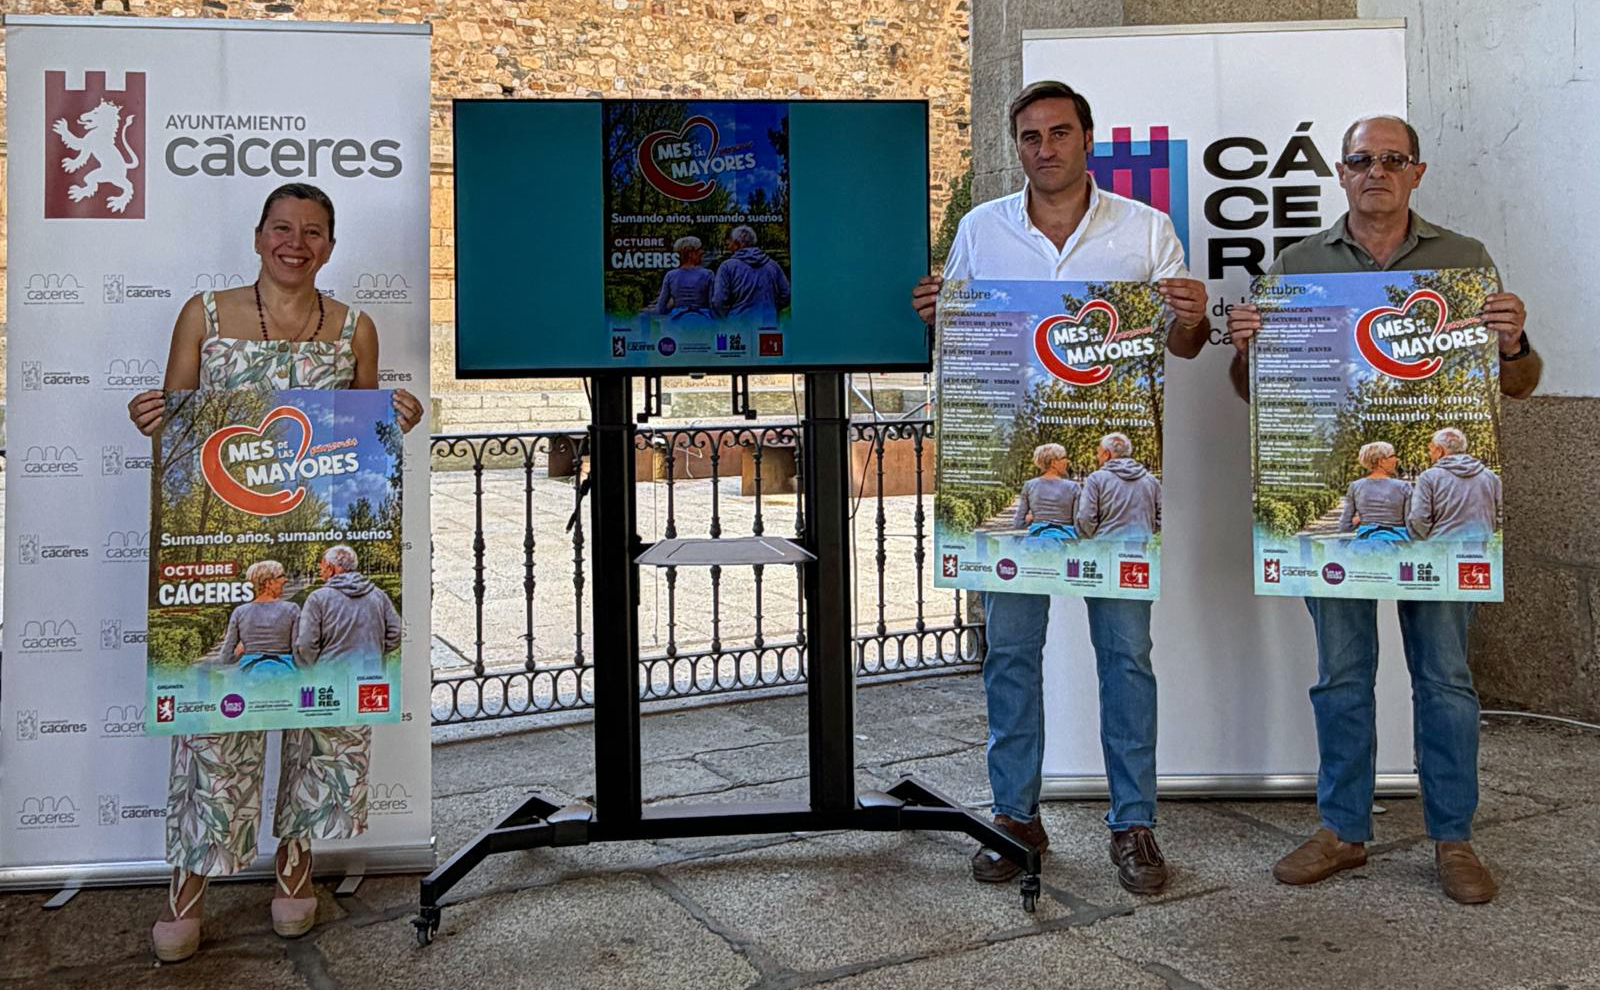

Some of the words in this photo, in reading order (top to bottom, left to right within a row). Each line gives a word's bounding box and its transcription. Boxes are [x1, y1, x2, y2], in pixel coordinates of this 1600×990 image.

[165, 114, 306, 131] AYUNTAMIENTO
[657, 142, 691, 161] MES
[1203, 121, 1334, 180] CÁ
[671, 153, 756, 179] MAYORES
[1204, 185, 1322, 231] CE
[611, 213, 664, 223] Sumando
[666, 213, 694, 225] años,
[696, 213, 745, 223] sumando
[747, 213, 783, 223] sueños
[614, 238, 665, 247] OCTUBRE
[611, 250, 680, 269] CÁCERES
[943, 288, 991, 300] Octubre
[1255, 284, 1306, 296] Octubre
[1053, 326, 1089, 345] MES
[1375, 318, 1415, 339] MES
[1417, 325, 1432, 334] LAS
[1090, 334, 1104, 343] LAS
[1391, 326, 1489, 359] MAYORES
[1066, 337, 1155, 365] MAYORES
[1039, 399, 1107, 410] Sumando
[1363, 394, 1438, 405] Sumando
[1359, 410, 1430, 421] sumando
[228, 439, 274, 463] MES
[277, 441, 289, 449] DE
[278, 449, 295, 459] LAS
[246, 452, 360, 487] MAYORES
[161, 532, 233, 546] Sumando
[236, 531, 274, 545] años,
[278, 529, 343, 542] sumando
[346, 528, 393, 541] sueños
[164, 563, 233, 576] OCTUBRE
[159, 580, 254, 606] CÁCERES
